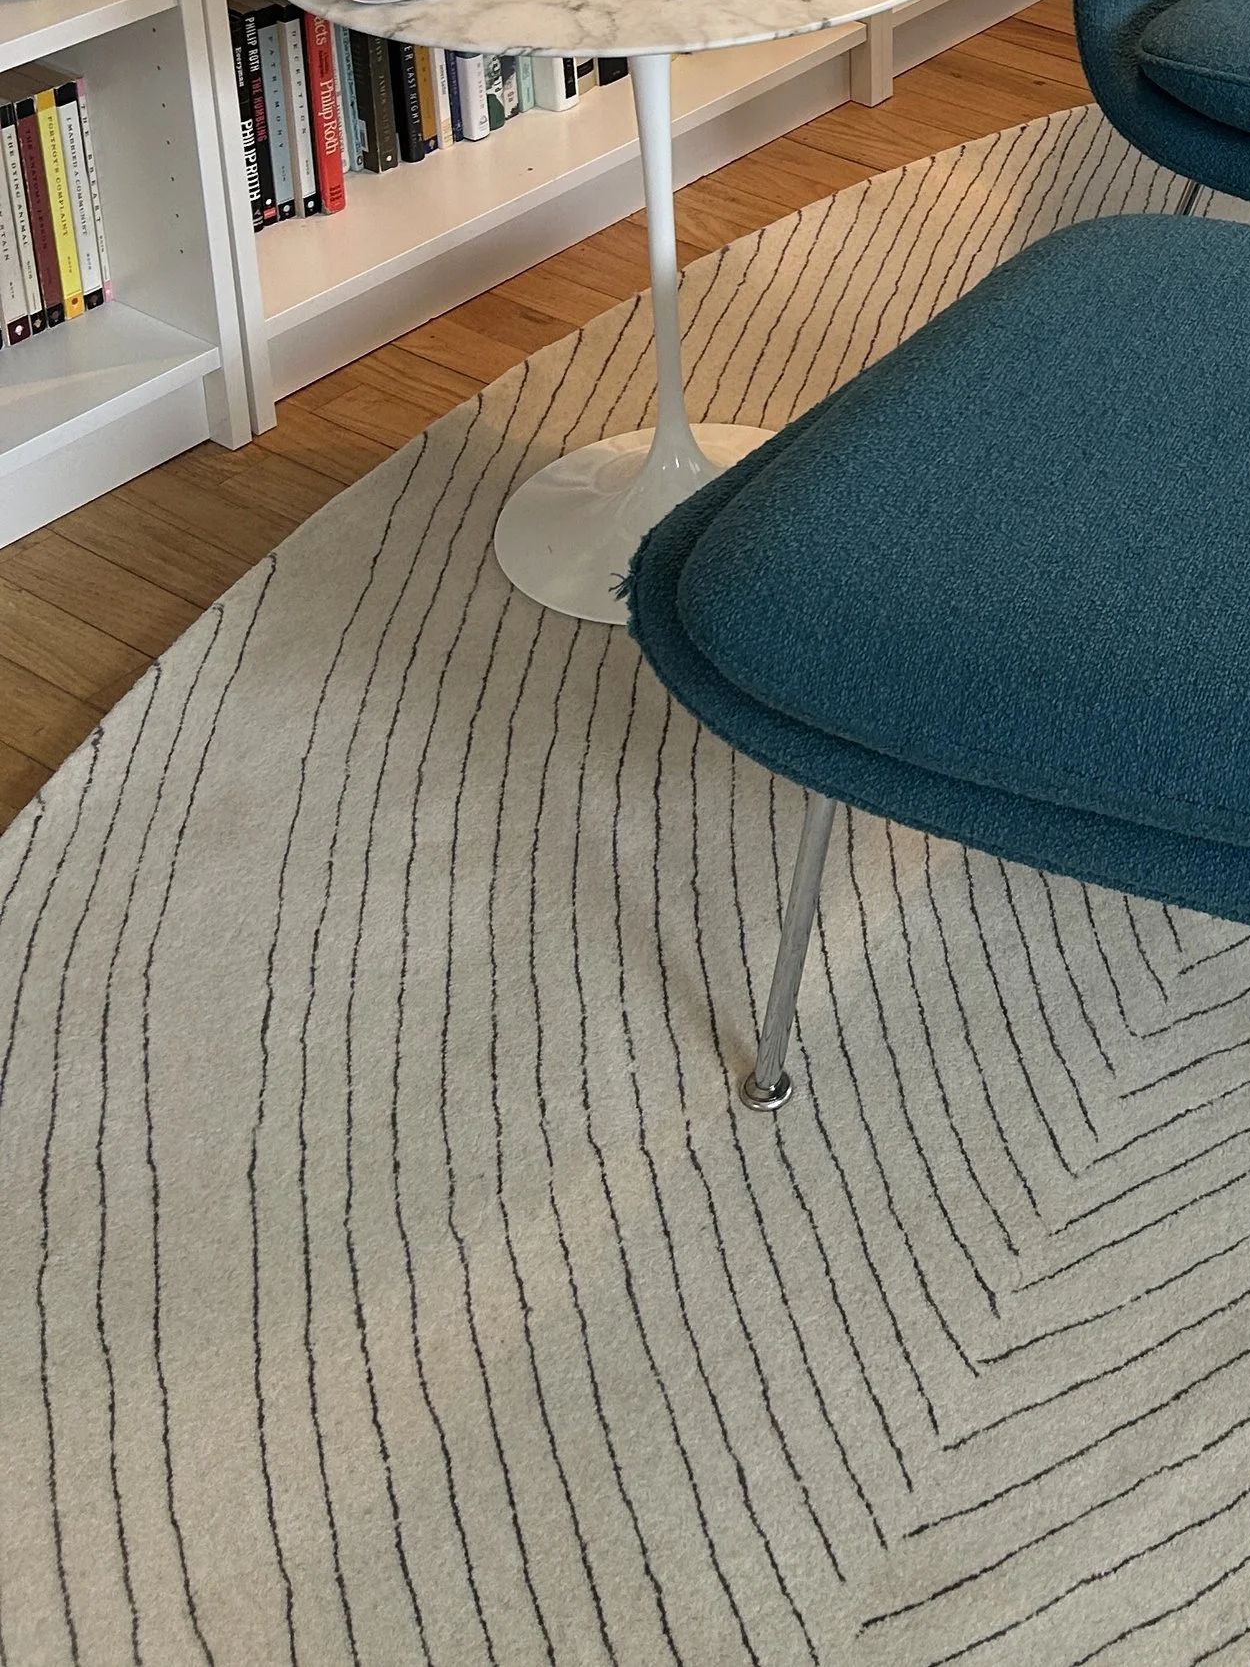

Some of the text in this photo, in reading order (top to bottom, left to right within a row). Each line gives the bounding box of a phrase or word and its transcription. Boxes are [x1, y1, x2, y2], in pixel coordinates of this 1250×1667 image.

[244, 16, 268, 142] PHILIP ROTH THE HUMBLING
[267, 36, 284, 149] PATRIMONY
[291, 30, 307, 135] DECEPTION
[317, 79, 336, 119] Philip
[405, 66, 415, 88] LAST
[408, 91, 420, 125] NIGHT
[323, 121, 339, 155] Roth
[55, 176, 69, 237] COMPLAINT
